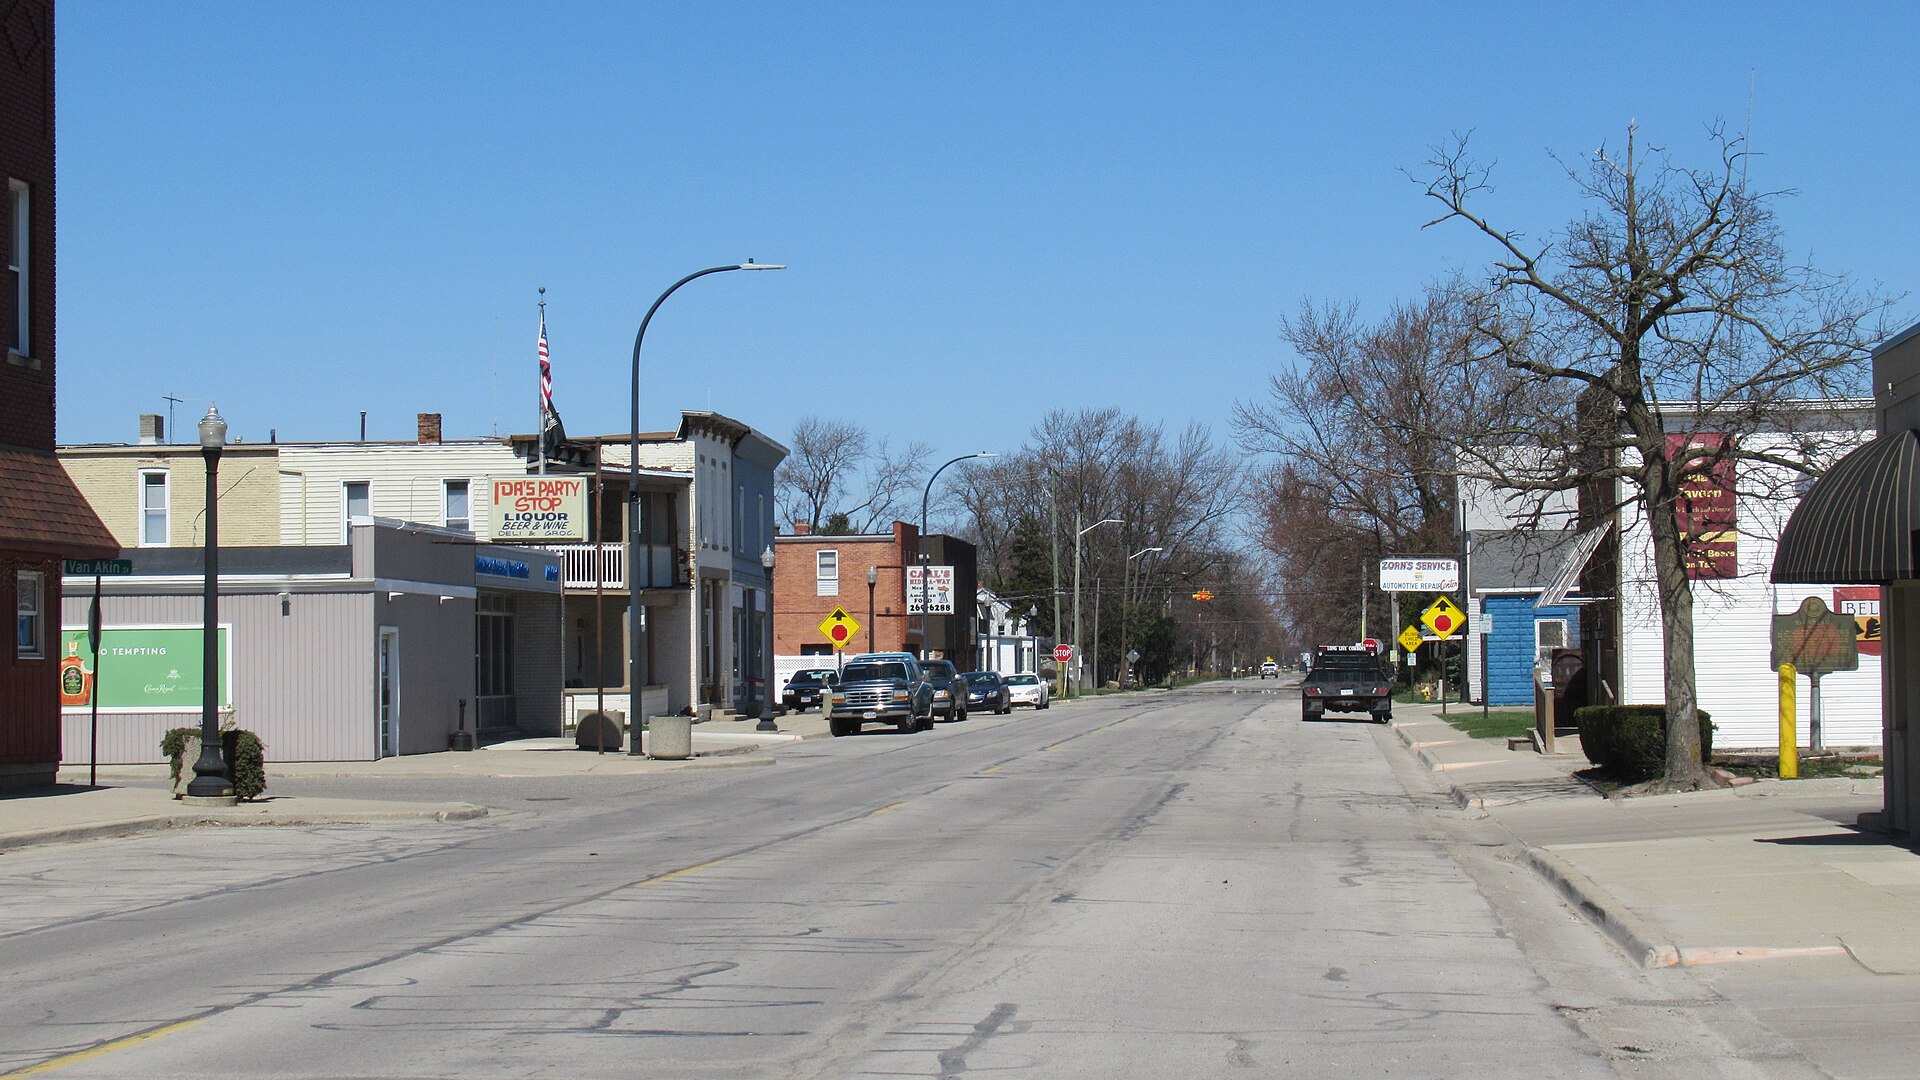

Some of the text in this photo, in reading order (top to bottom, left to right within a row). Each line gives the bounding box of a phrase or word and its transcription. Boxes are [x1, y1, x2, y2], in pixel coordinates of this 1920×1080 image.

[494, 480, 580, 505] IDA'S PARTY
[514, 497, 563, 512] STOP
[504, 512, 568, 521] LIQUOR
[502, 521, 570, 530] BEER & WINE
[68, 560, 90, 573] Van
[95, 560, 120, 573] Akin
[1381, 561, 1414, 571] ZORN'S
[1415, 561, 1451, 571] SERVICE
[1382, 582, 1419, 590] AUTOMOTIVE
[1420, 582, 1441, 590] REPAIR
[112, 647, 167, 655] TEMPTING
[1055, 649, 1070, 657] STOP
